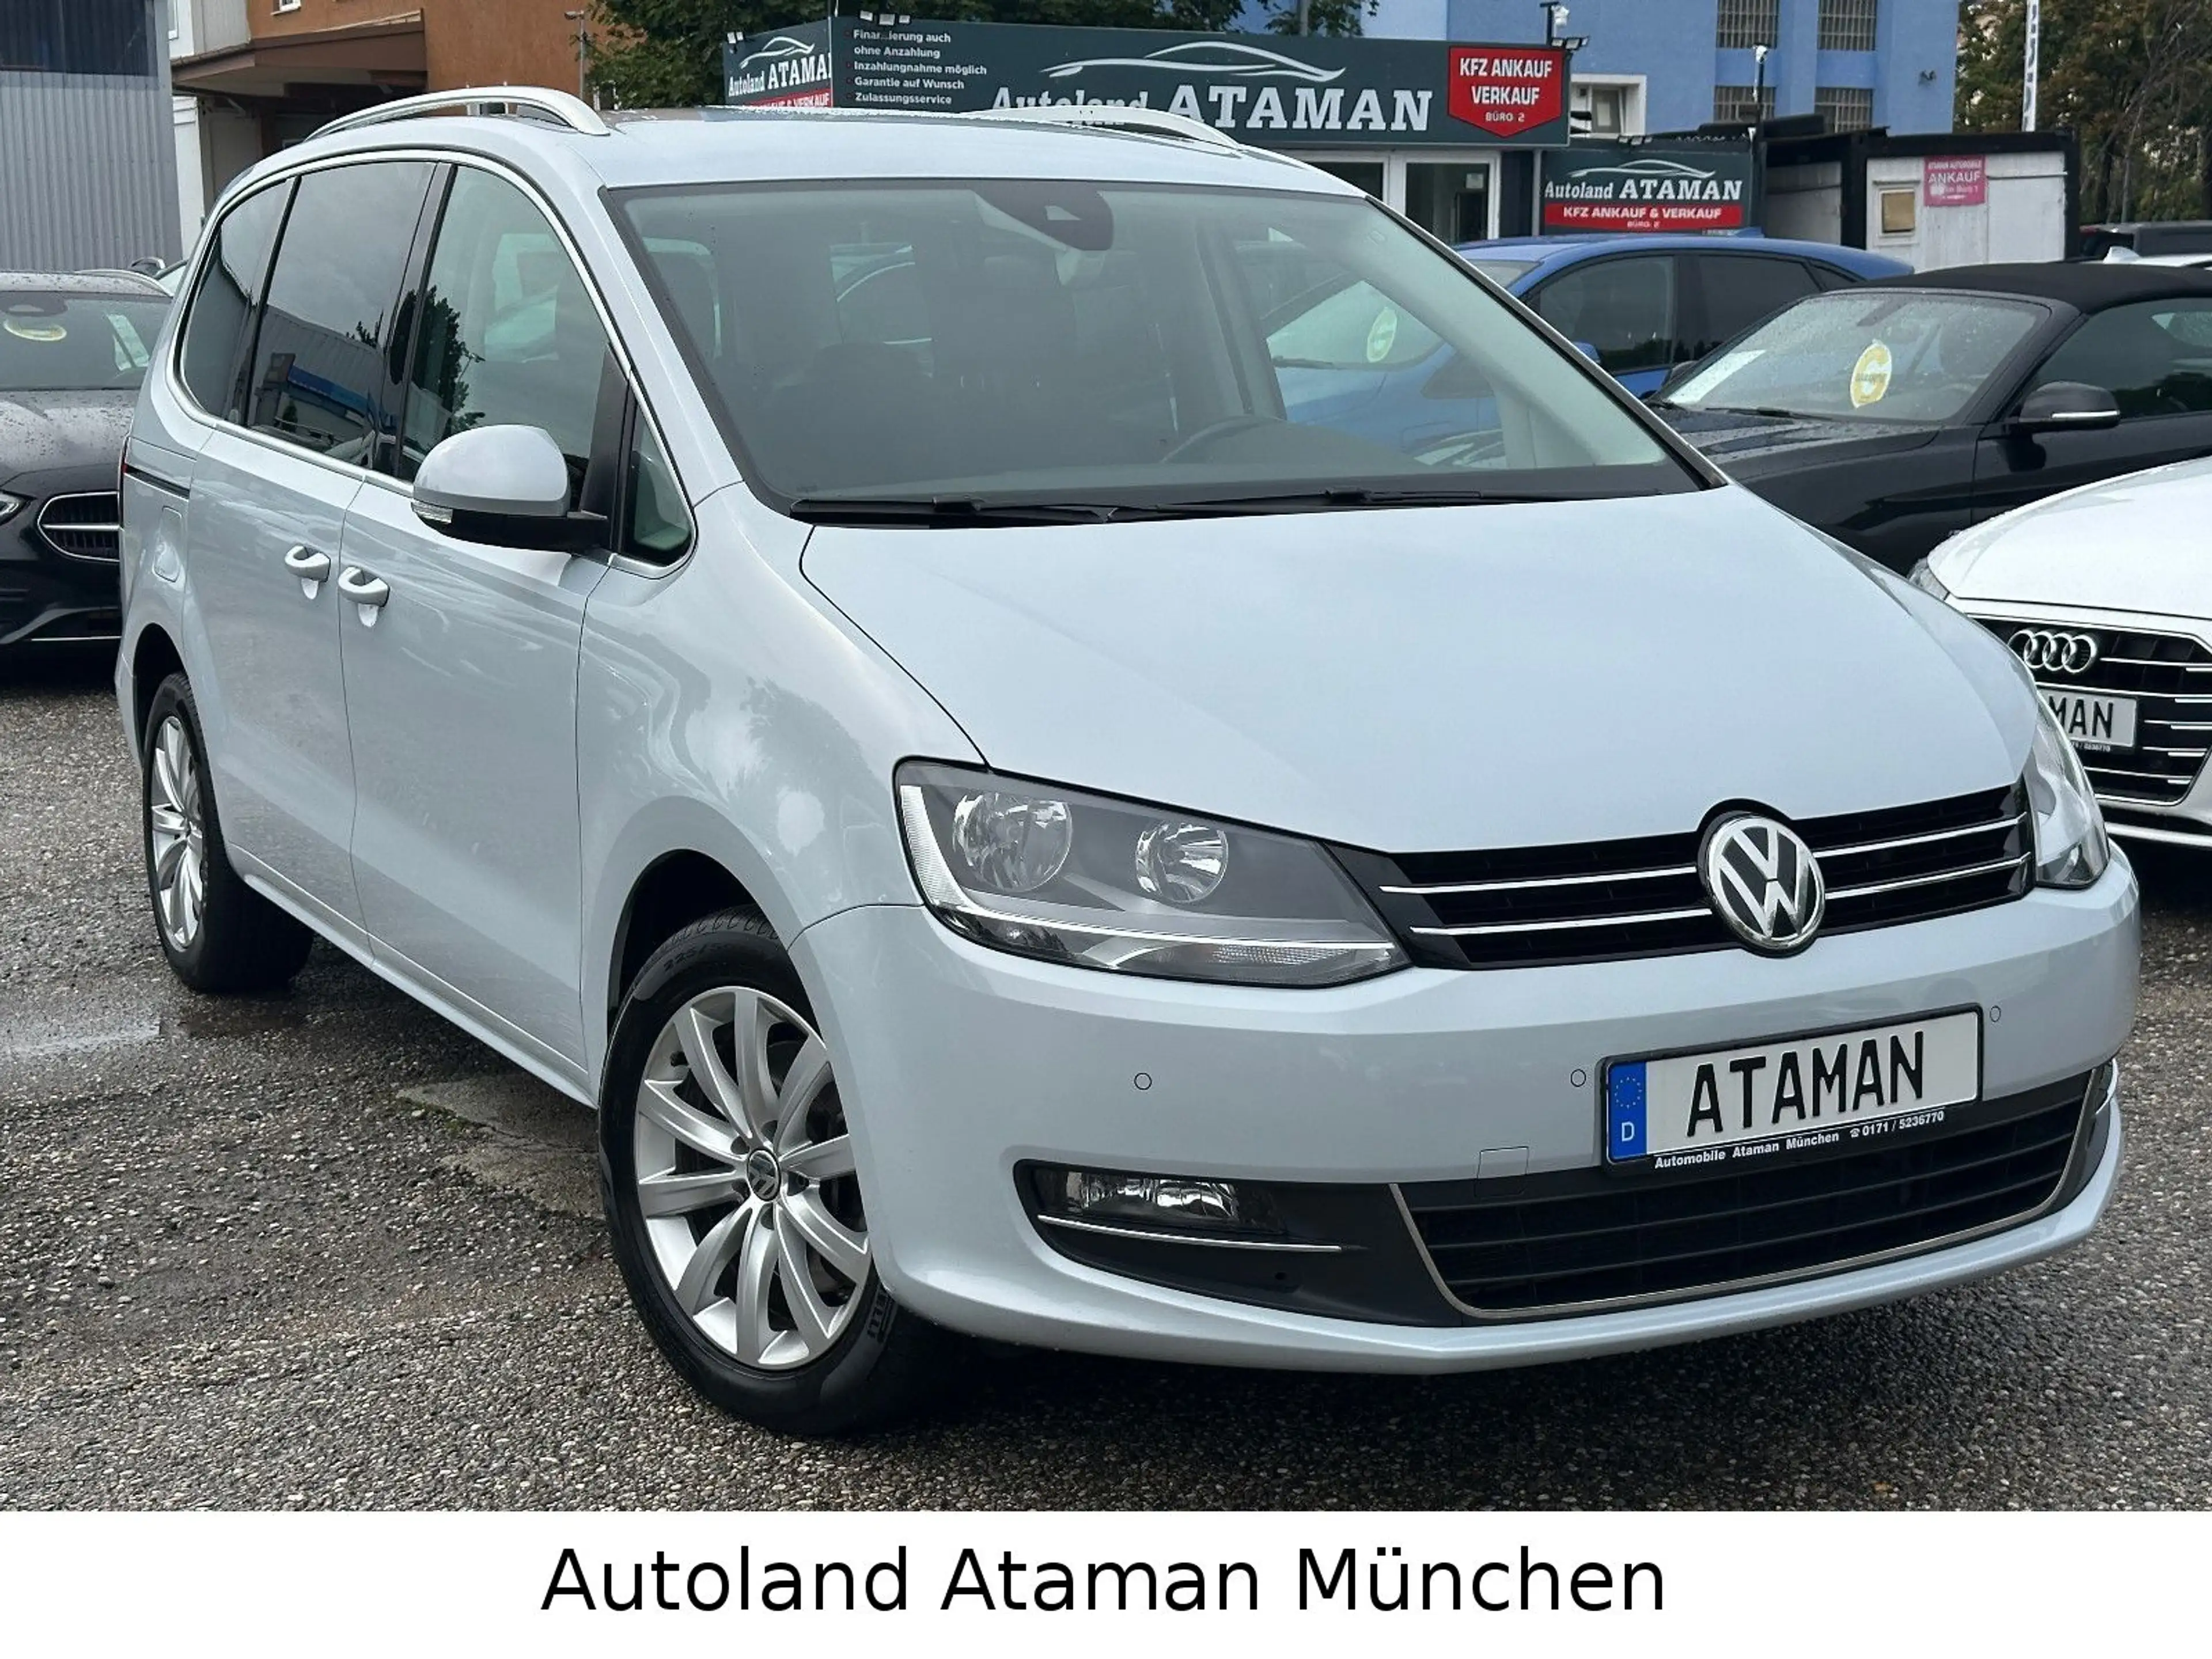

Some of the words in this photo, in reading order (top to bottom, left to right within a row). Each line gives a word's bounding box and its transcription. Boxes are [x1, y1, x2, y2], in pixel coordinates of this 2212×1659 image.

[854, 29, 923, 43] Finaierung
[926, 33, 950, 43] auch
[854, 46, 881, 55] ohne
[884, 47, 941, 59] Anzahlung
[854, 61, 942, 73] Inzahlungnahme
[945, 65, 987, 75] möglich
[1460, 58, 1488, 76] KFZ
[1491, 59, 1552, 78] ANKAUF
[728, 70, 765, 97] Autoland
[855, 77, 900, 86] Garantie
[903, 79, 920, 88] auf
[922, 79, 964, 89] Wunsch
[855, 93, 952, 104] Zulassungsservice
[1472, 86, 1540, 105] VERKAUF
[1168, 85, 1432, 131] ATAMAN
[1486, 112, 1513, 122] BÜRO
[1518, 112, 1525, 122] 2
[1929, 171, 1980, 184] ANKAUF
[1544, 181, 1613, 199] Autoland
[1619, 179, 1743, 200] ATAMAN
[1563, 207, 1588, 218] KFZ
[1591, 207, 1646, 218] ANKAUF
[1649, 208, 1658, 218] &
[1662, 208, 1722, 219] VERKAUF
[1687, 1031, 1923, 1136] ATAMAN
[1621, 1120, 1634, 1142] D
[1654, 1149, 1726, 1169] Automobile
[1732, 1142, 1779, 1159] Ataman
[1785, 1132, 1840, 1150] München
[1862, 1123, 1889, 1136] 0171
[1899, 1109, 1945, 1130] 5236770
